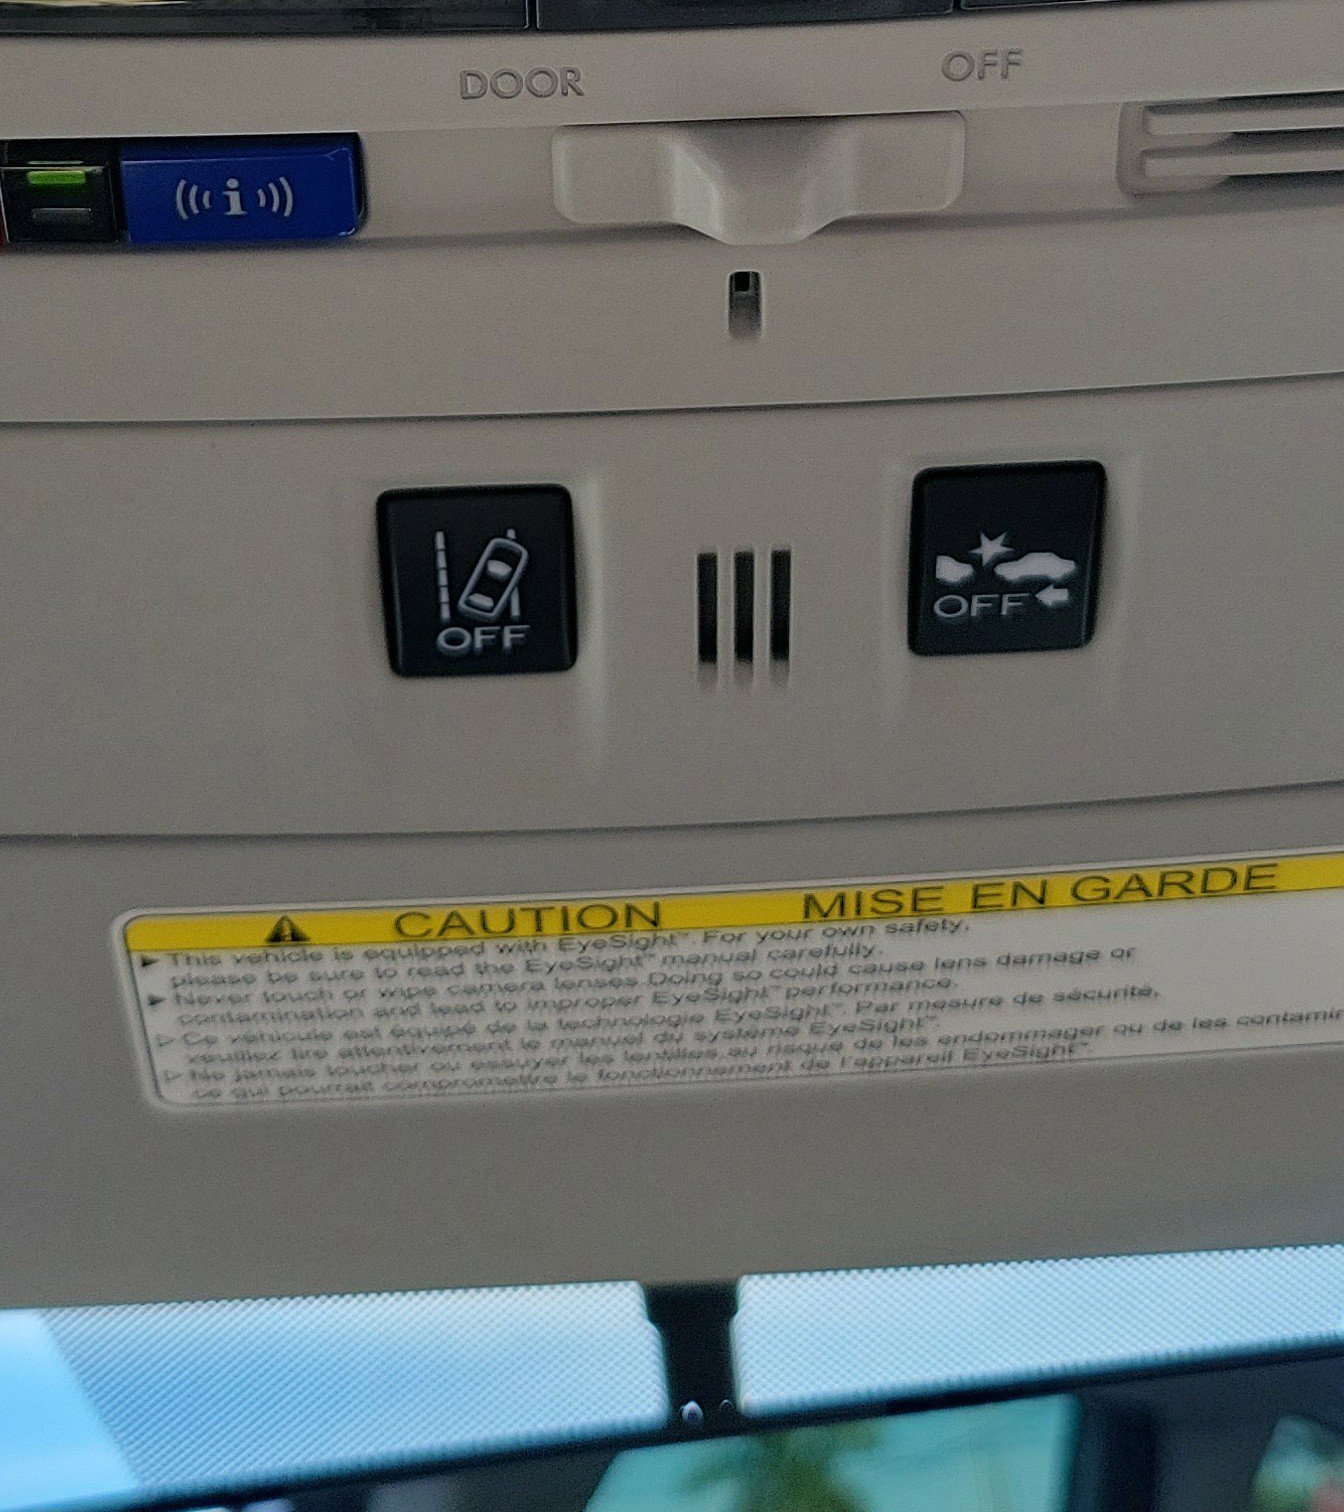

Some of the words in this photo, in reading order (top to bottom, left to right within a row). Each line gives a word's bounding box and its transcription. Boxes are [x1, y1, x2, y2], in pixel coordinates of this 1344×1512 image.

[941, 49, 1024, 81] OFF
[459, 67, 585, 99] DOOR
[932, 592, 1029, 619] OFF
[436, 624, 530, 655] OFF
[802, 885, 945, 919] MISE
[971, 878, 1048, 910] EN
[1070, 862, 1279, 902] GARDE
[393, 900, 661, 938] CAUTION
[496, 938, 547, 954] with
[703, 930, 746, 944] For
[757, 928, 813, 944] your
[821, 924, 875, 938] own
[343, 987, 365, 999] or
[648, 970, 723, 985] Doing
[732, 969, 762, 981] so
[769, 962, 838, 979] could
[848, 960, 924, 974] cause
[933, 956, 987, 969] lens
[995, 950, 1100, 966] damage
[1110, 948, 1136, 959] or
[373, 965, 397, 979] to
[474, 959, 514, 974] the
[661, 948, 756, 966] manual
[494, 998, 517, 1012] to
[908, 994, 1003, 1011] mesure
[1013, 989, 1044, 1005] de
[1152, 1018, 1183, 1033] de
[1191, 1016, 1226, 1030] les
